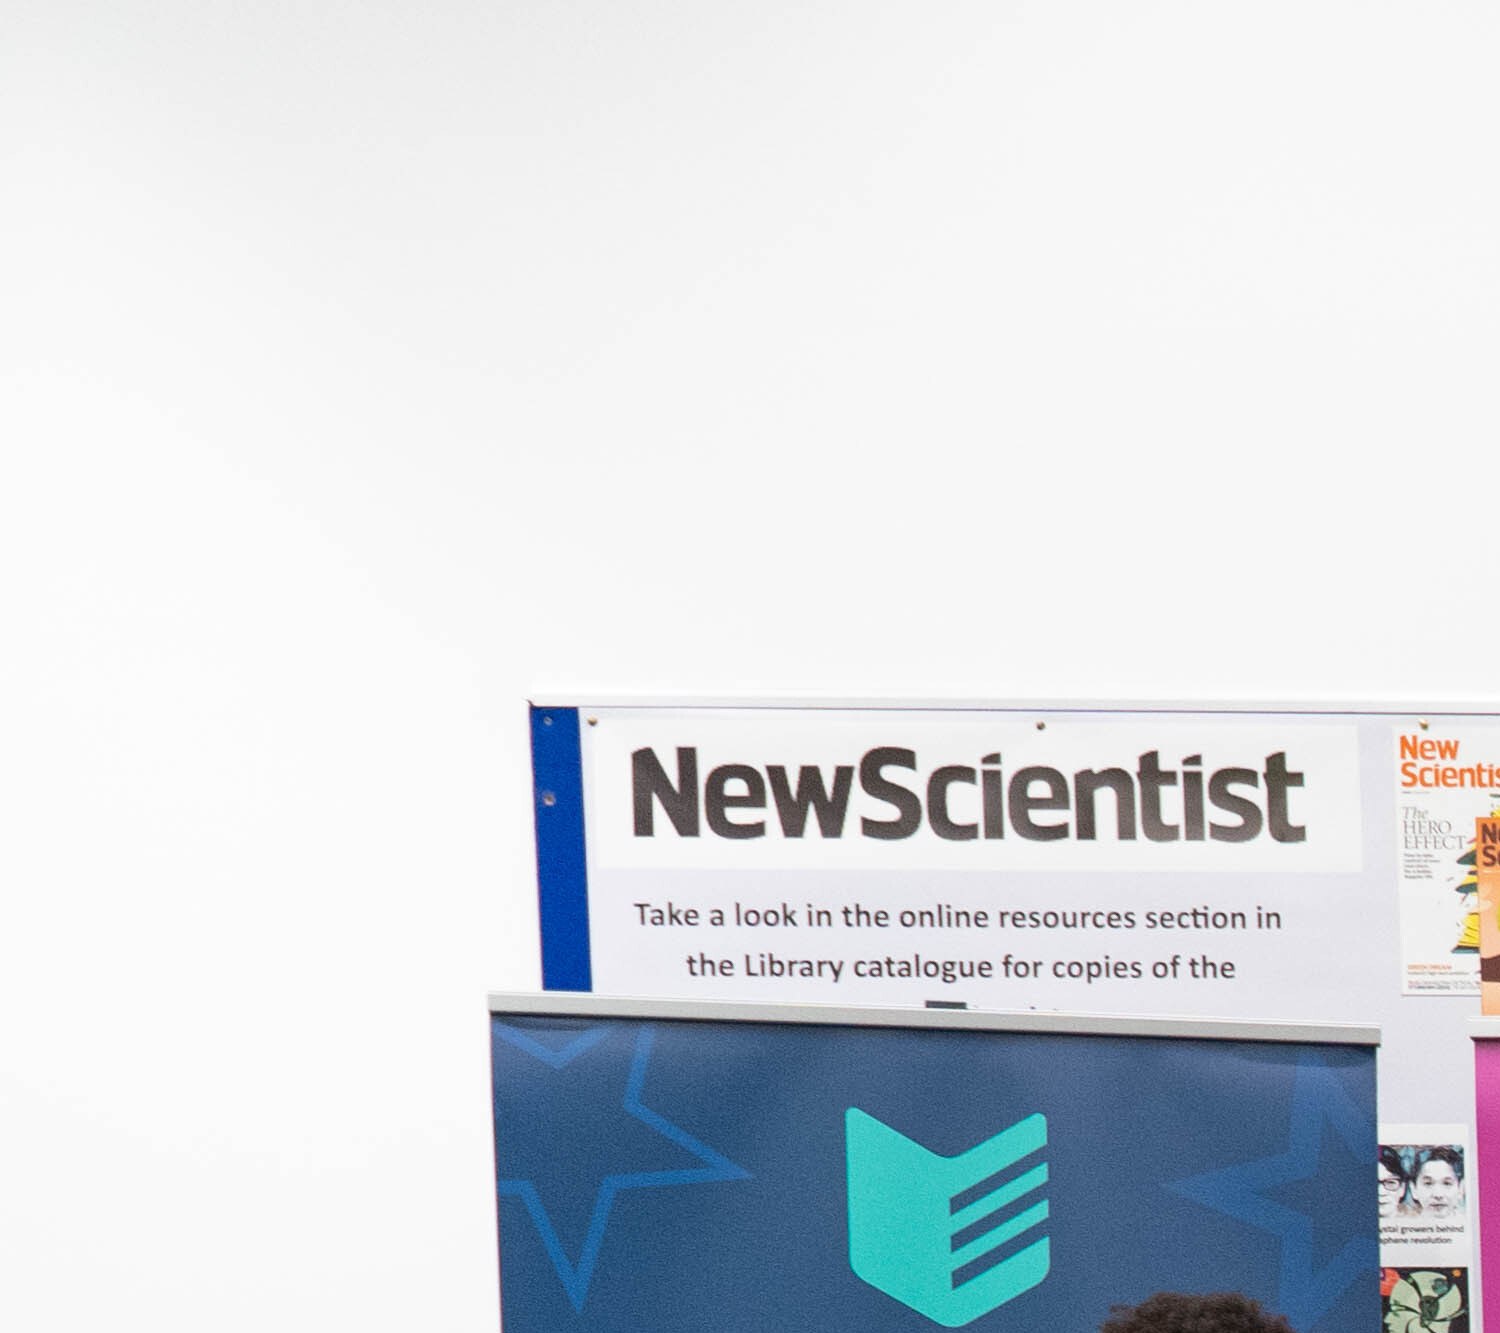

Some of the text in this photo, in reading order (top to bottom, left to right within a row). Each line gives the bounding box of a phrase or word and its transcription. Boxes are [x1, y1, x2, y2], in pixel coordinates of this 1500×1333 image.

[1399, 735, 1460, 760] New
[1402, 806, 1430, 820] The
[1403, 820, 1452, 834] HERO
[1404, 835, 1466, 850] EFFECT
[635, 902, 1283, 931] Take a look in the online resources section in
[686, 953, 1236, 986] the Library catalogue for copies of the
[1436, 1224, 1465, 1233] behind
[1410, 1235, 1453, 1244] revolution
